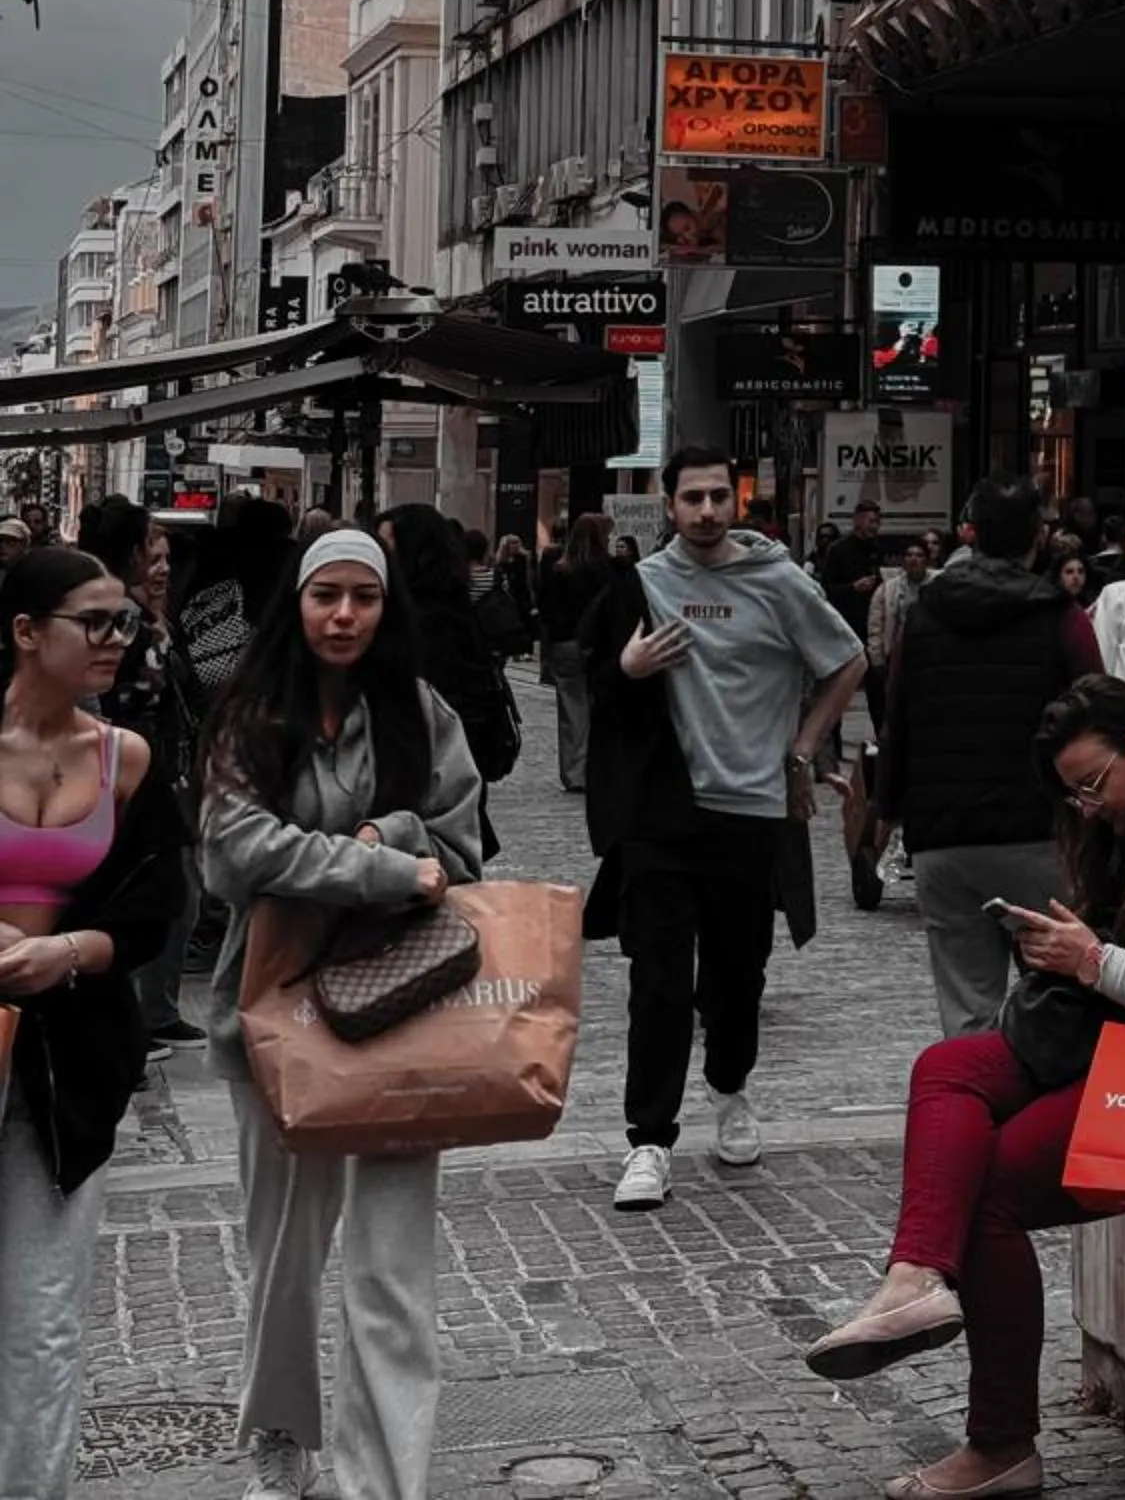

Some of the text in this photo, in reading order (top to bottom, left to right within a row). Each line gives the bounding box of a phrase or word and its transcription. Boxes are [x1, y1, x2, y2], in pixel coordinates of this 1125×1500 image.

[686, 61, 807, 88] ΑΓΟΡΑ
[669, 85, 819, 113] ΧΡΥΣΟΥ
[509, 236, 649, 260] pink woman
[522, 285, 657, 314] attrattivo
